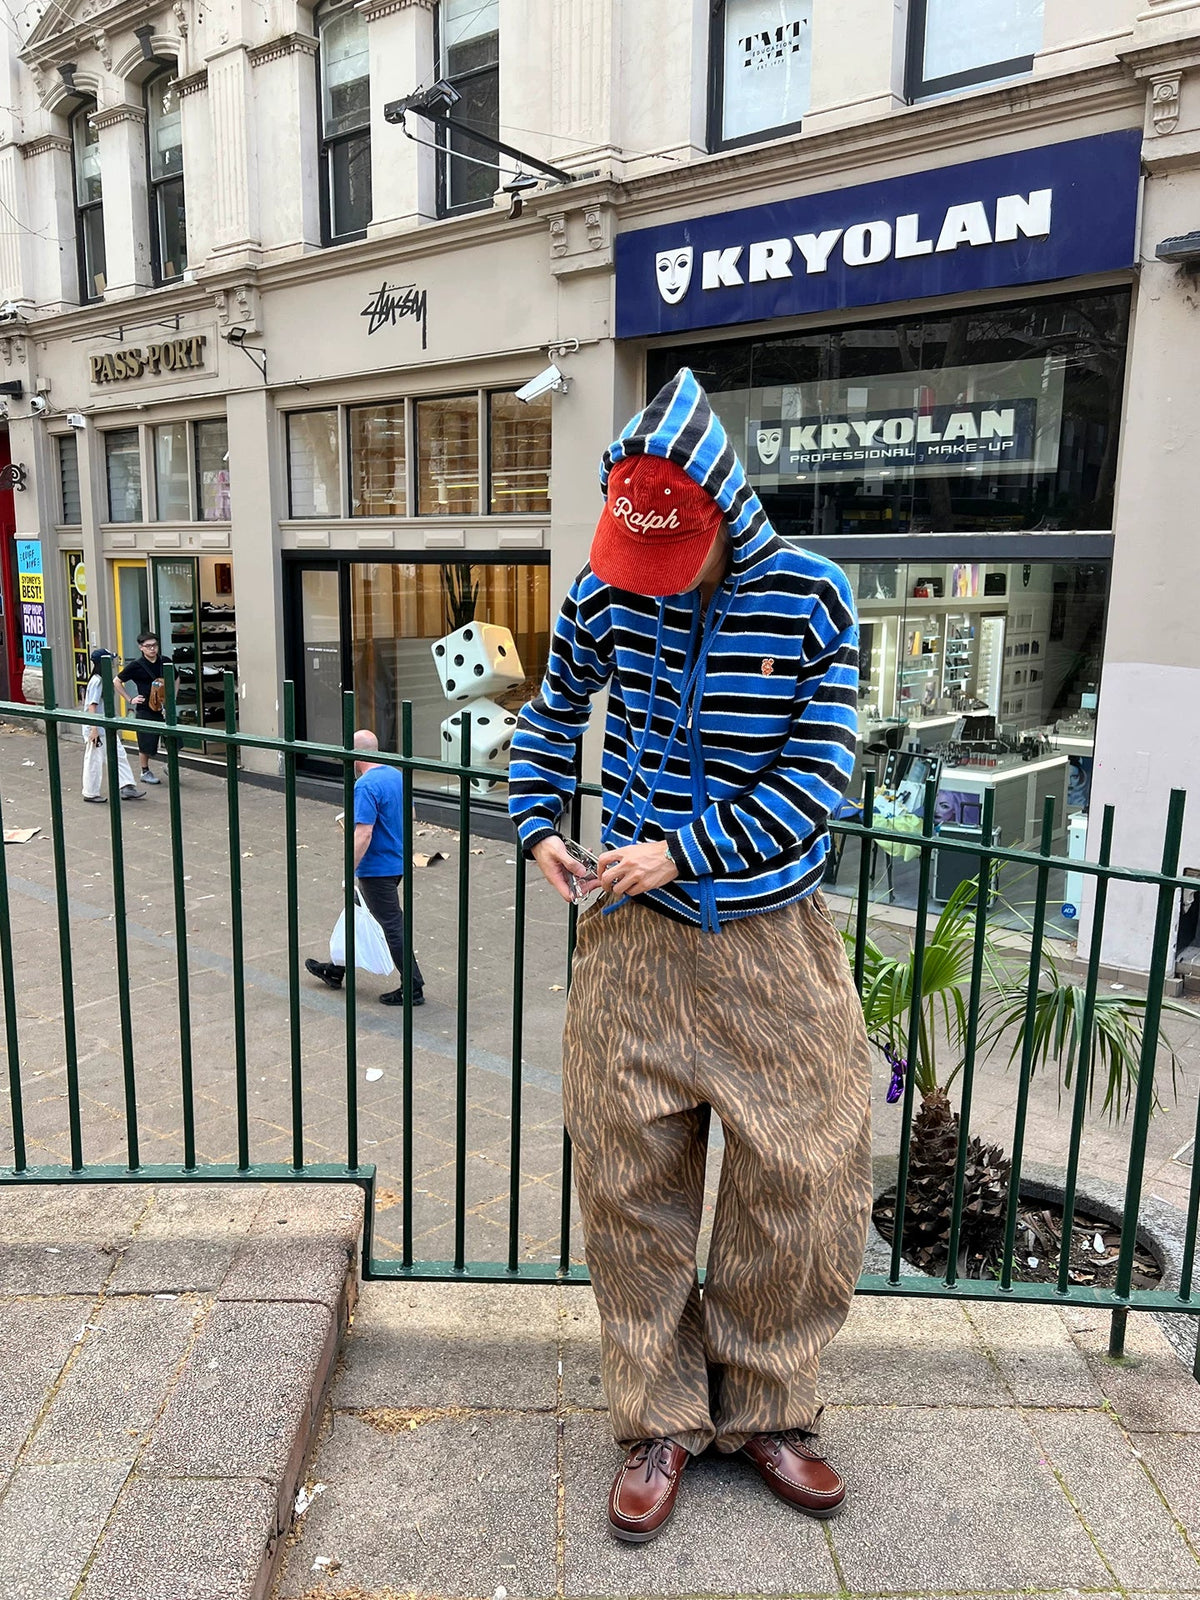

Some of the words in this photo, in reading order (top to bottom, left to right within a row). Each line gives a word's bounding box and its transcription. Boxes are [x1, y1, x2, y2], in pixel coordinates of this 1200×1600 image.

[752, 40, 793, 57] EDUCATION
[702, 188, 1053, 290] KRYOLAN
[789, 408, 1015, 451] KRYOLAN
[790, 447, 916, 464] PROFESSIONAL
[927, 441, 1014, 455] MAKE-UP
[613, 496, 680, 534] Ralph
[22, 576, 41, 585] SYDNEY'S
[22, 585, 41, 599] BEST!
[23, 603, 31, 615] HIP
[24, 614, 43, 635] RNB
